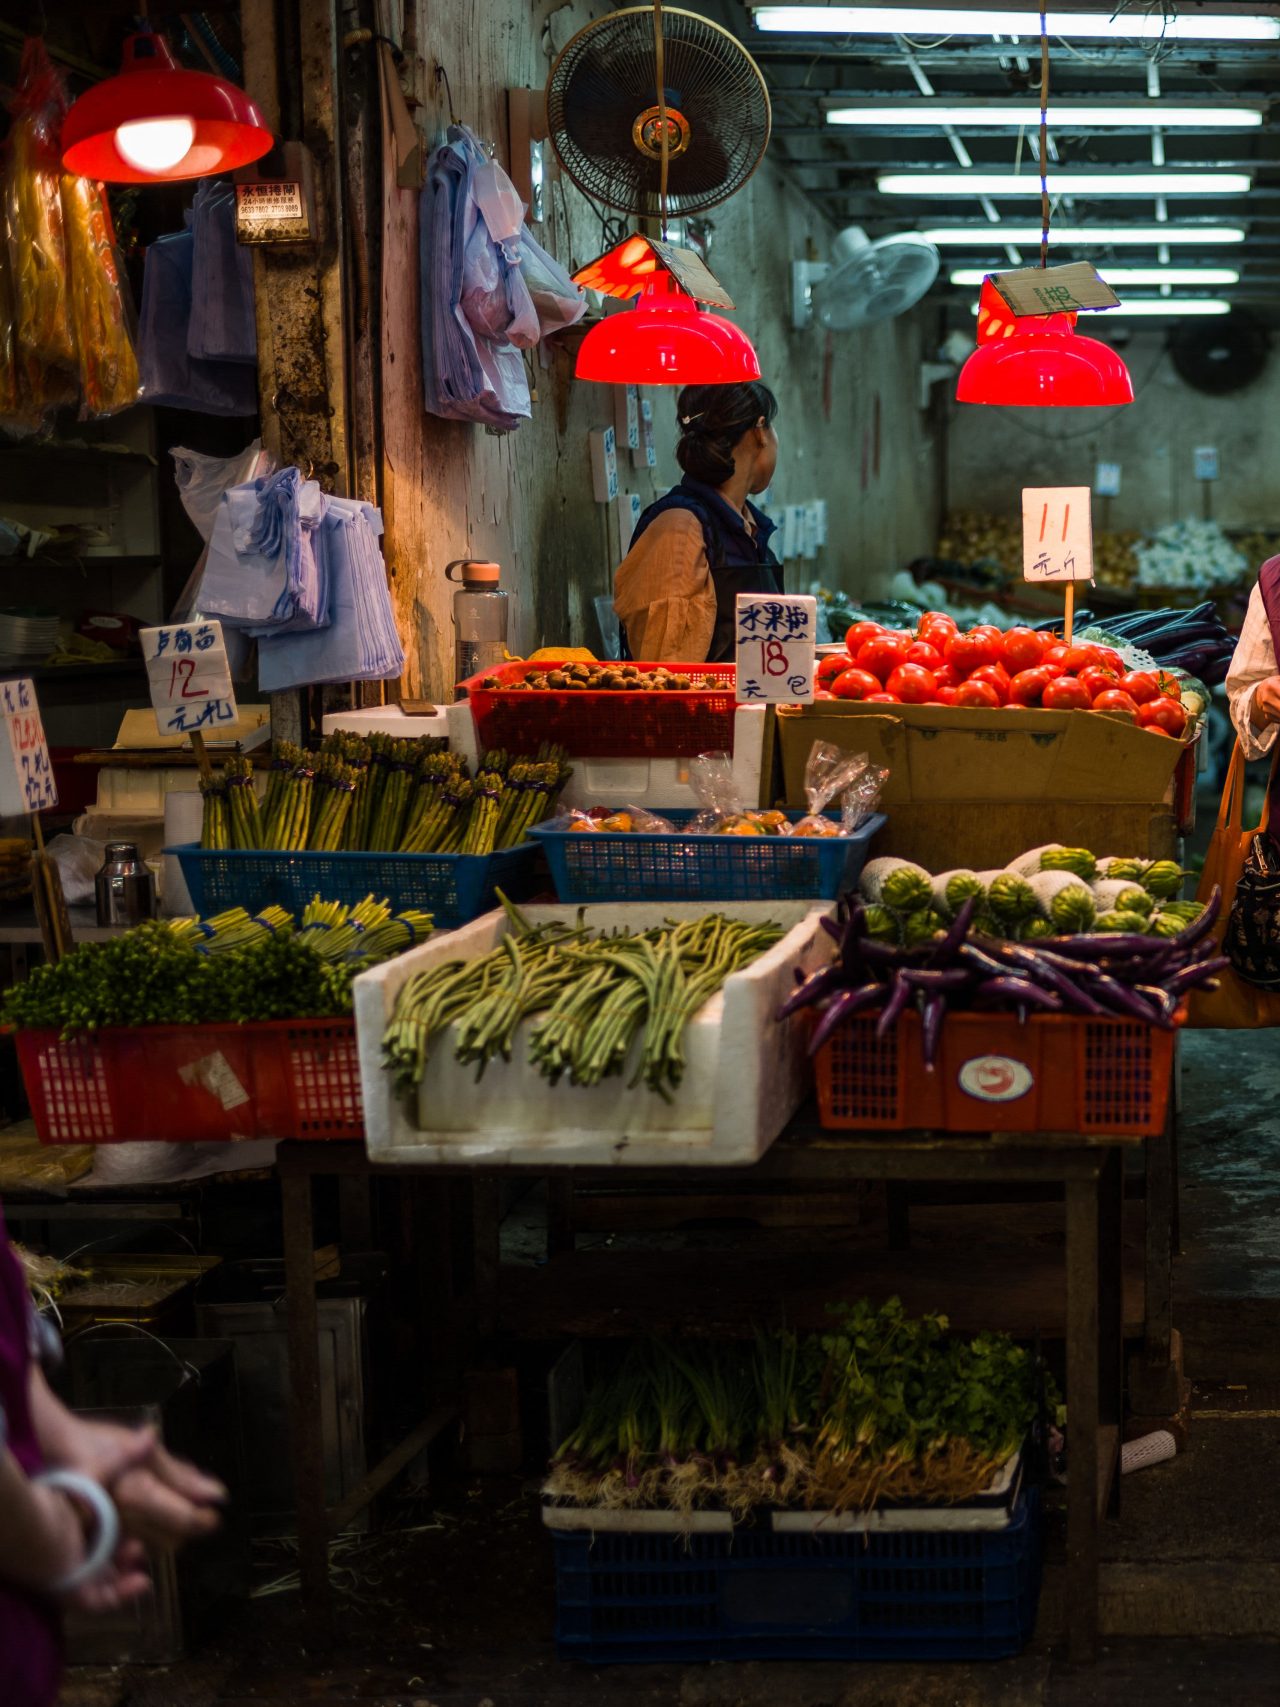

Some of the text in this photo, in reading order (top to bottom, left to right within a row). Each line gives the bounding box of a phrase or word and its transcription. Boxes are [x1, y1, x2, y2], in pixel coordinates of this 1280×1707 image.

[1039, 503, 1070, 542] 11
[761, 641, 788, 676] 18
[169, 659, 209, 698] 12
